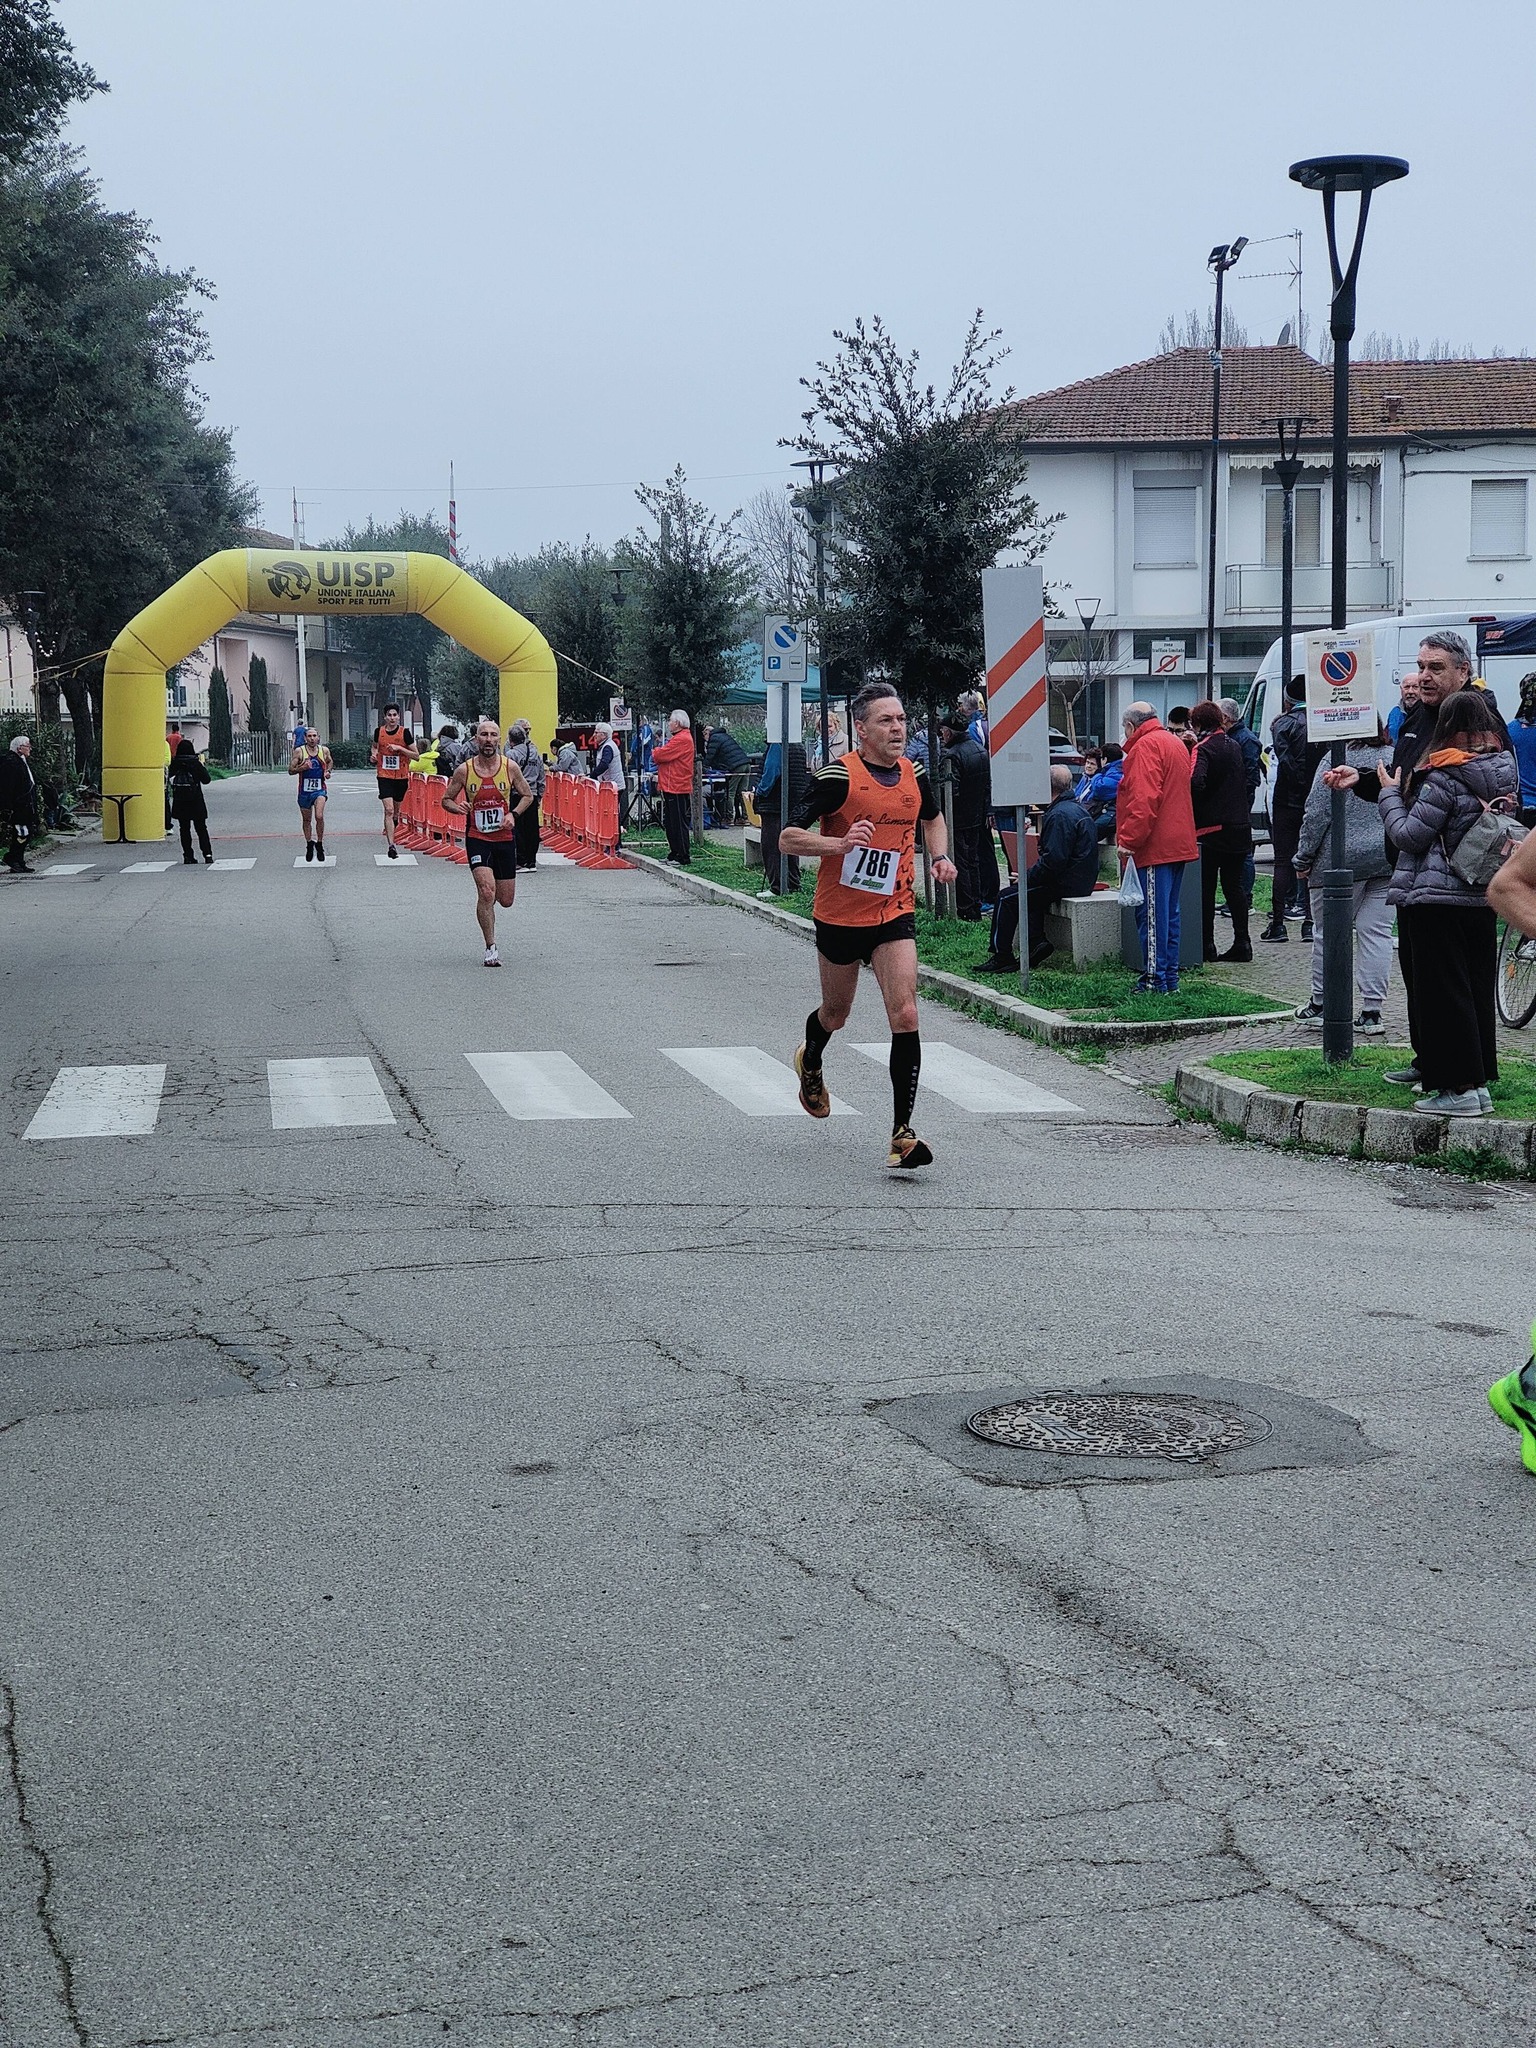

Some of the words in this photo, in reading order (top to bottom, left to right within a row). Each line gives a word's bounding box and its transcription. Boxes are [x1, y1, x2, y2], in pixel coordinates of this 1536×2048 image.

[316, 561, 395, 587] UISP
[317, 588, 352, 597] UNIONE
[356, 588, 396, 597] ITALIANA
[317, 597, 345, 605] SPORT
[770, 657, 779, 668] P
[307, 778, 319, 788] 726
[480, 809, 500, 826] 762
[854, 847, 891, 879] 786
